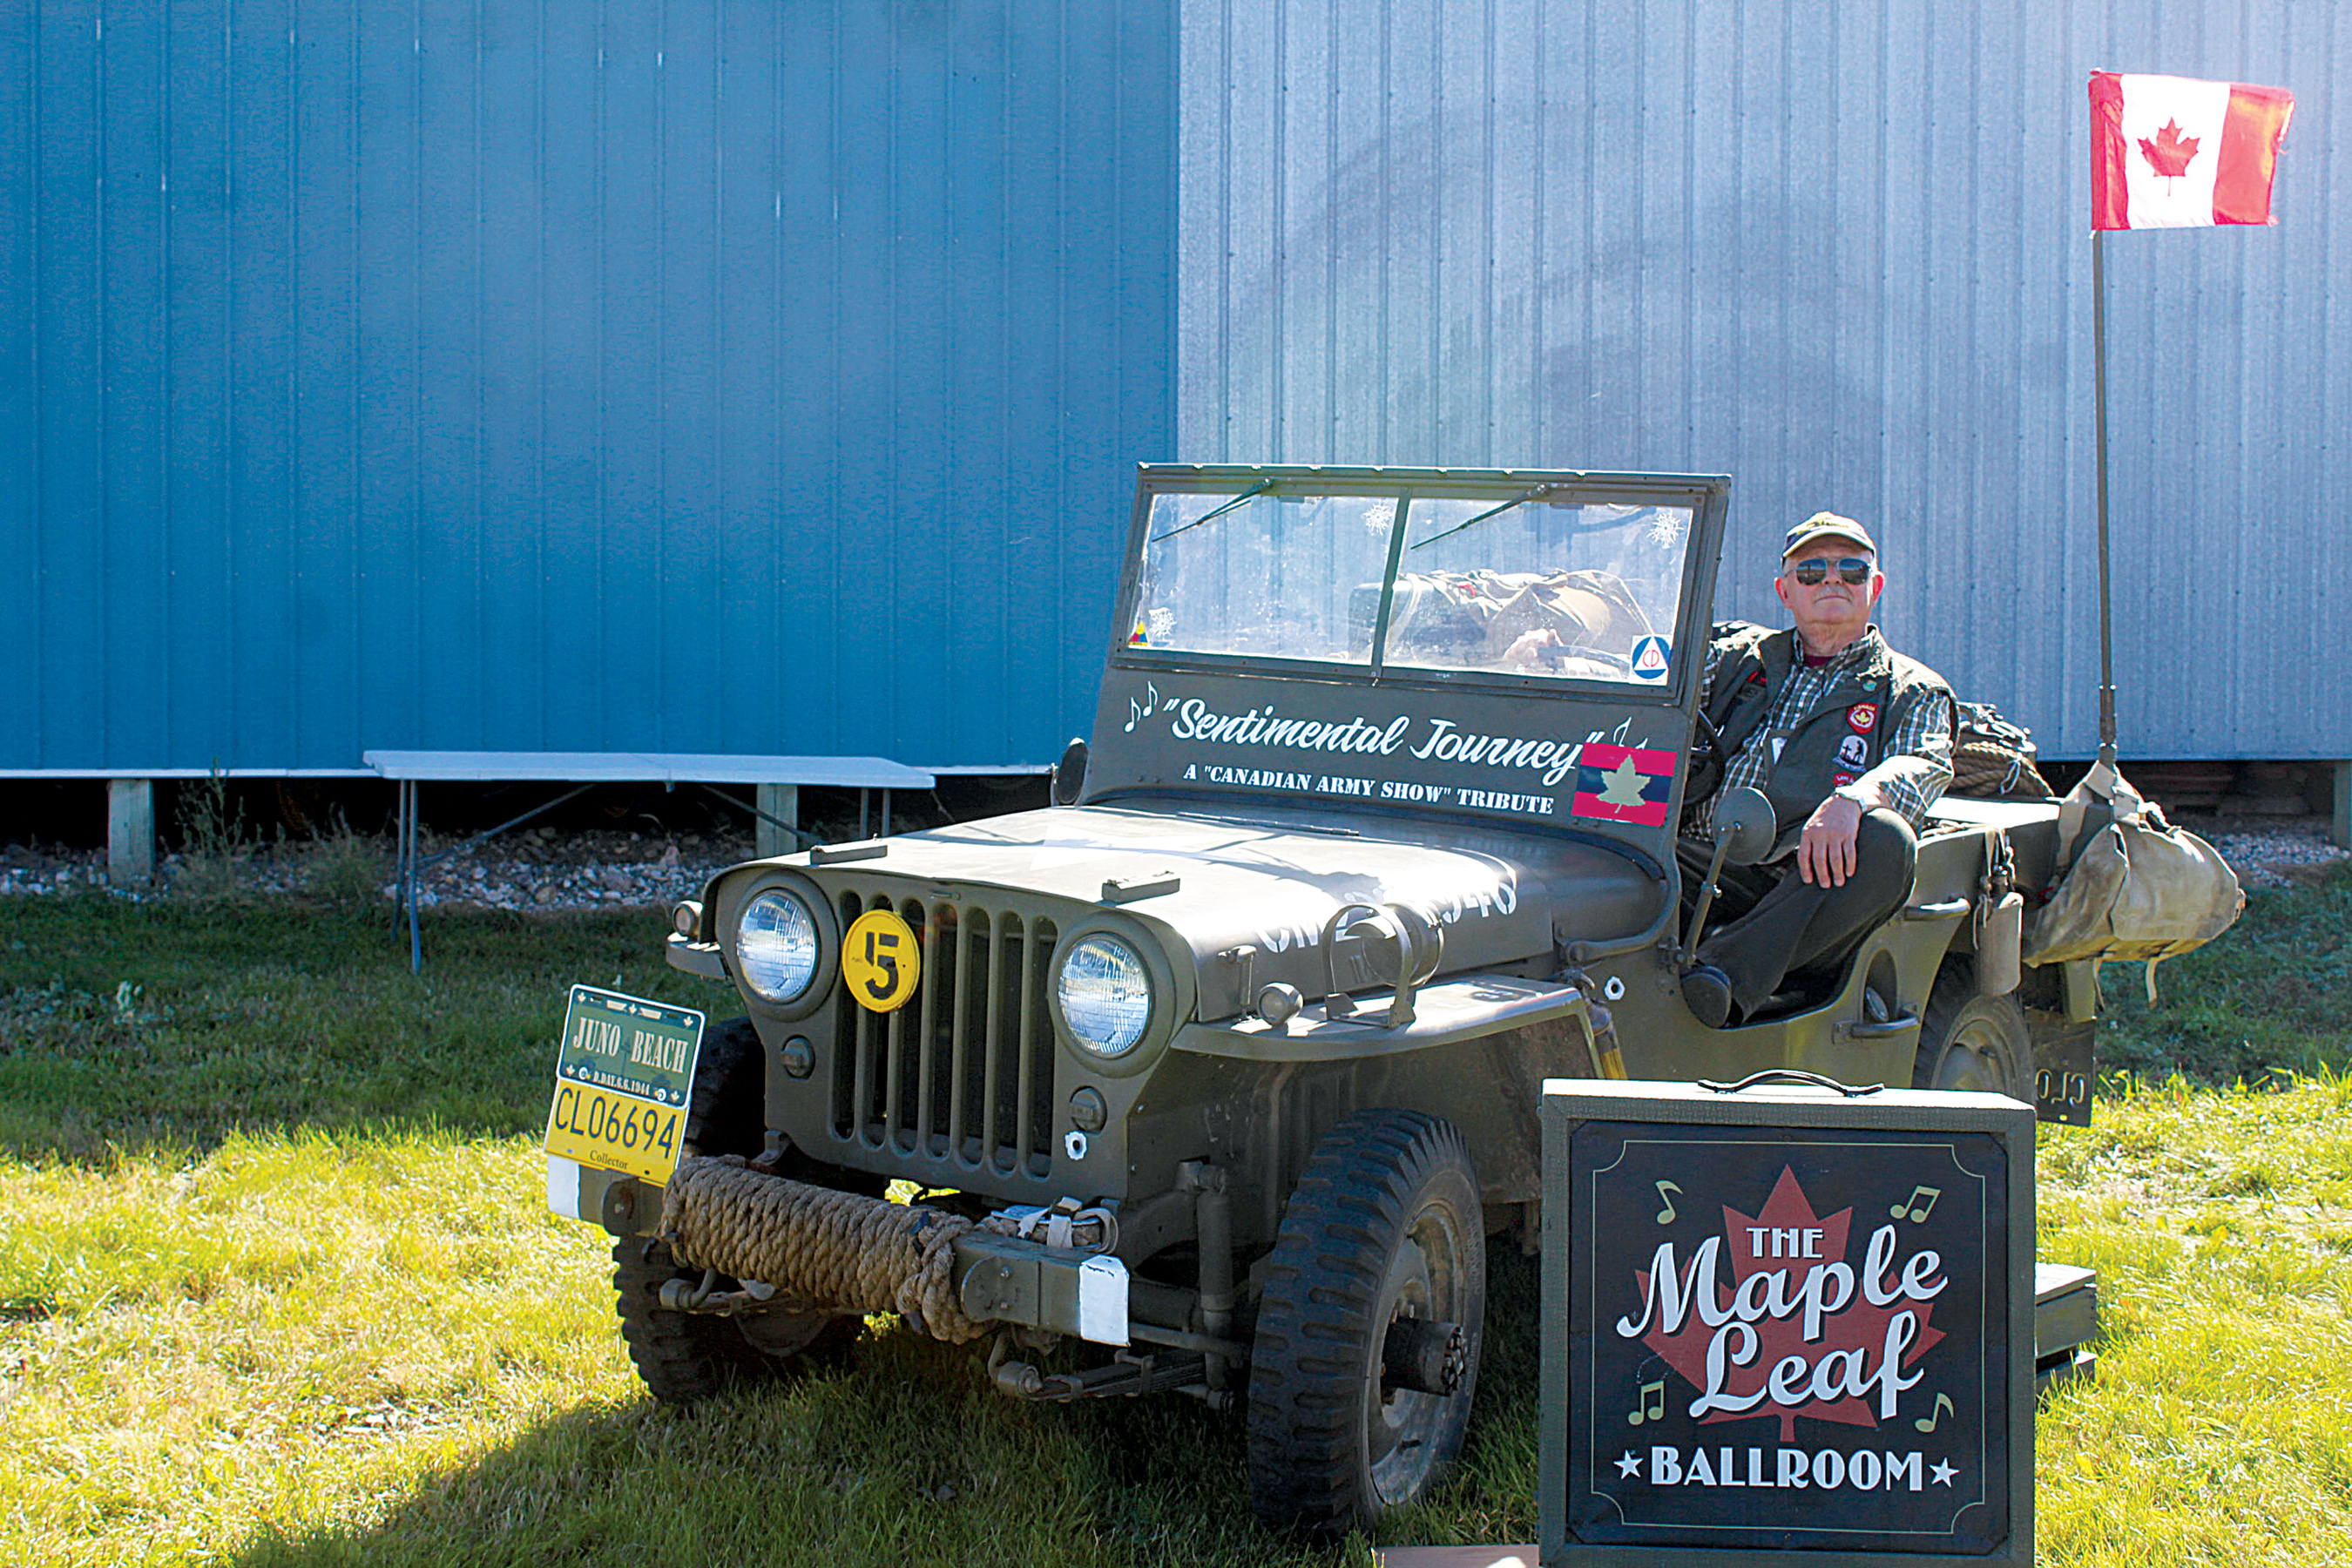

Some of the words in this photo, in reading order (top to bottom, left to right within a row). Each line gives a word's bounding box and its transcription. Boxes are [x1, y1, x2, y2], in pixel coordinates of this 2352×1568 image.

[1183, 764, 1198, 781] A
[1204, 765, 1312, 791] "CANADIAN
[1315, 774, 1375, 797] ARMY
[1380, 781, 1451, 803] SHOW"
[1456, 787, 1554, 815] TRIBUTE
[863, 931, 900, 1001] 5
[572, 1016, 621, 1058] JUNO
[630, 1030, 689, 1075] BEACH
[589, 1149, 629, 1171] Collector
[1746, 1227, 1824, 1260] THE
[1616, 1224, 1949, 1342] Maple
[1688, 1309, 1925, 1420] Leaf
[1651, 1446, 1923, 1491] BALLROOM
